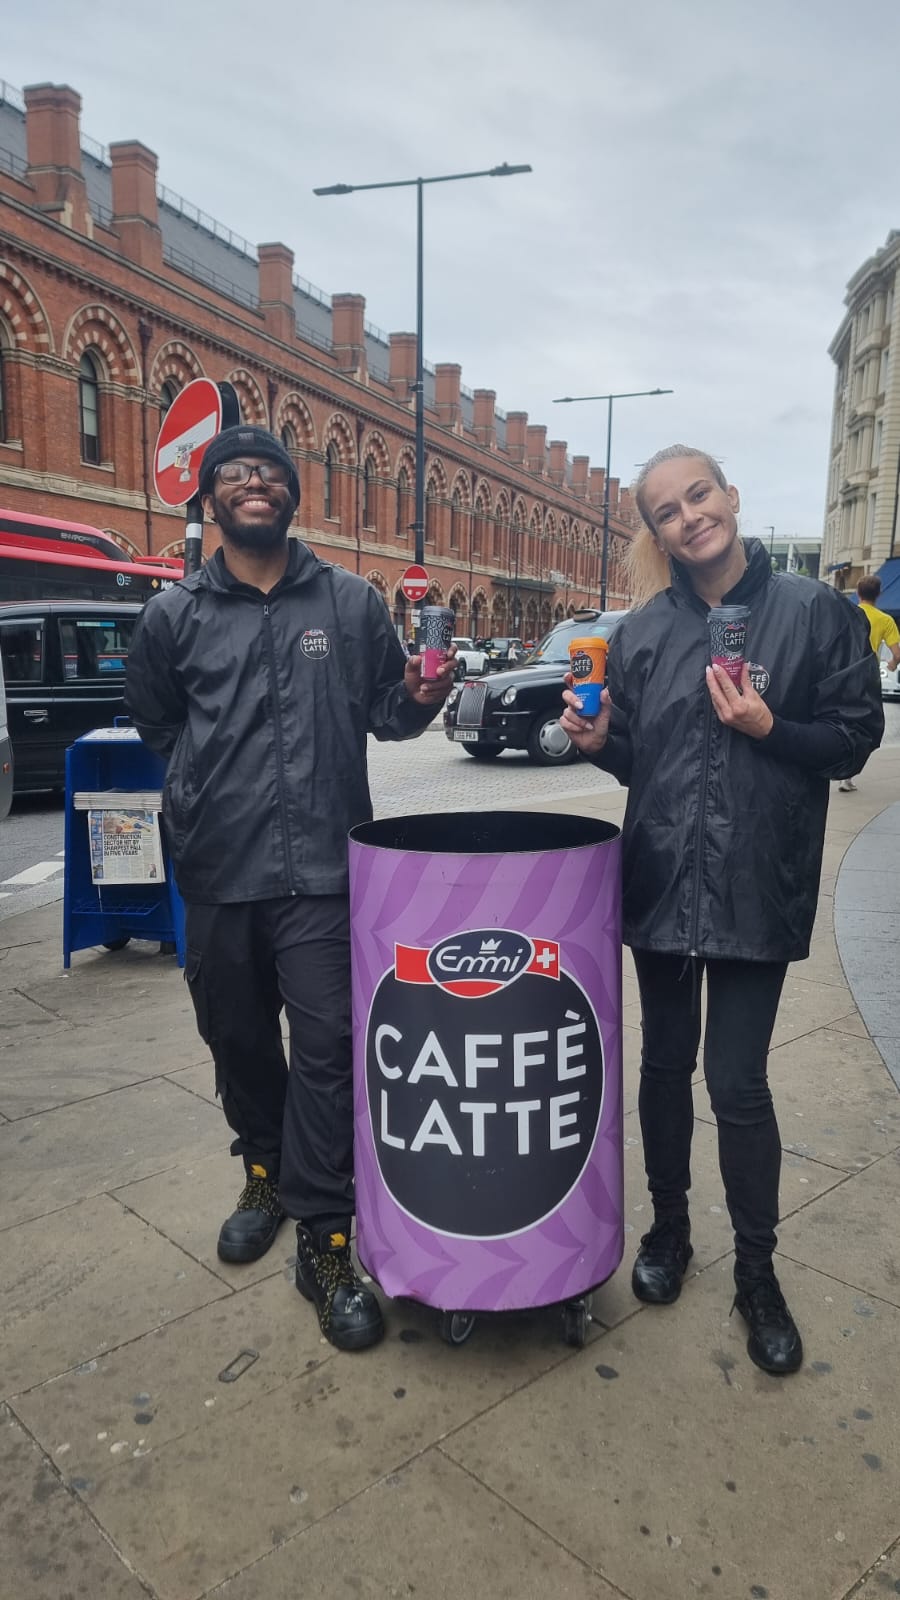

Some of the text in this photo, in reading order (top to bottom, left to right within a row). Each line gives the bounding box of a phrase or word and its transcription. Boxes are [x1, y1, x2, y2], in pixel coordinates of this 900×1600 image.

[436, 944, 523, 974] Emmi
[375, 1010, 587, 1088] CAFFÈ
[380, 1088, 581, 1156] LATTE
